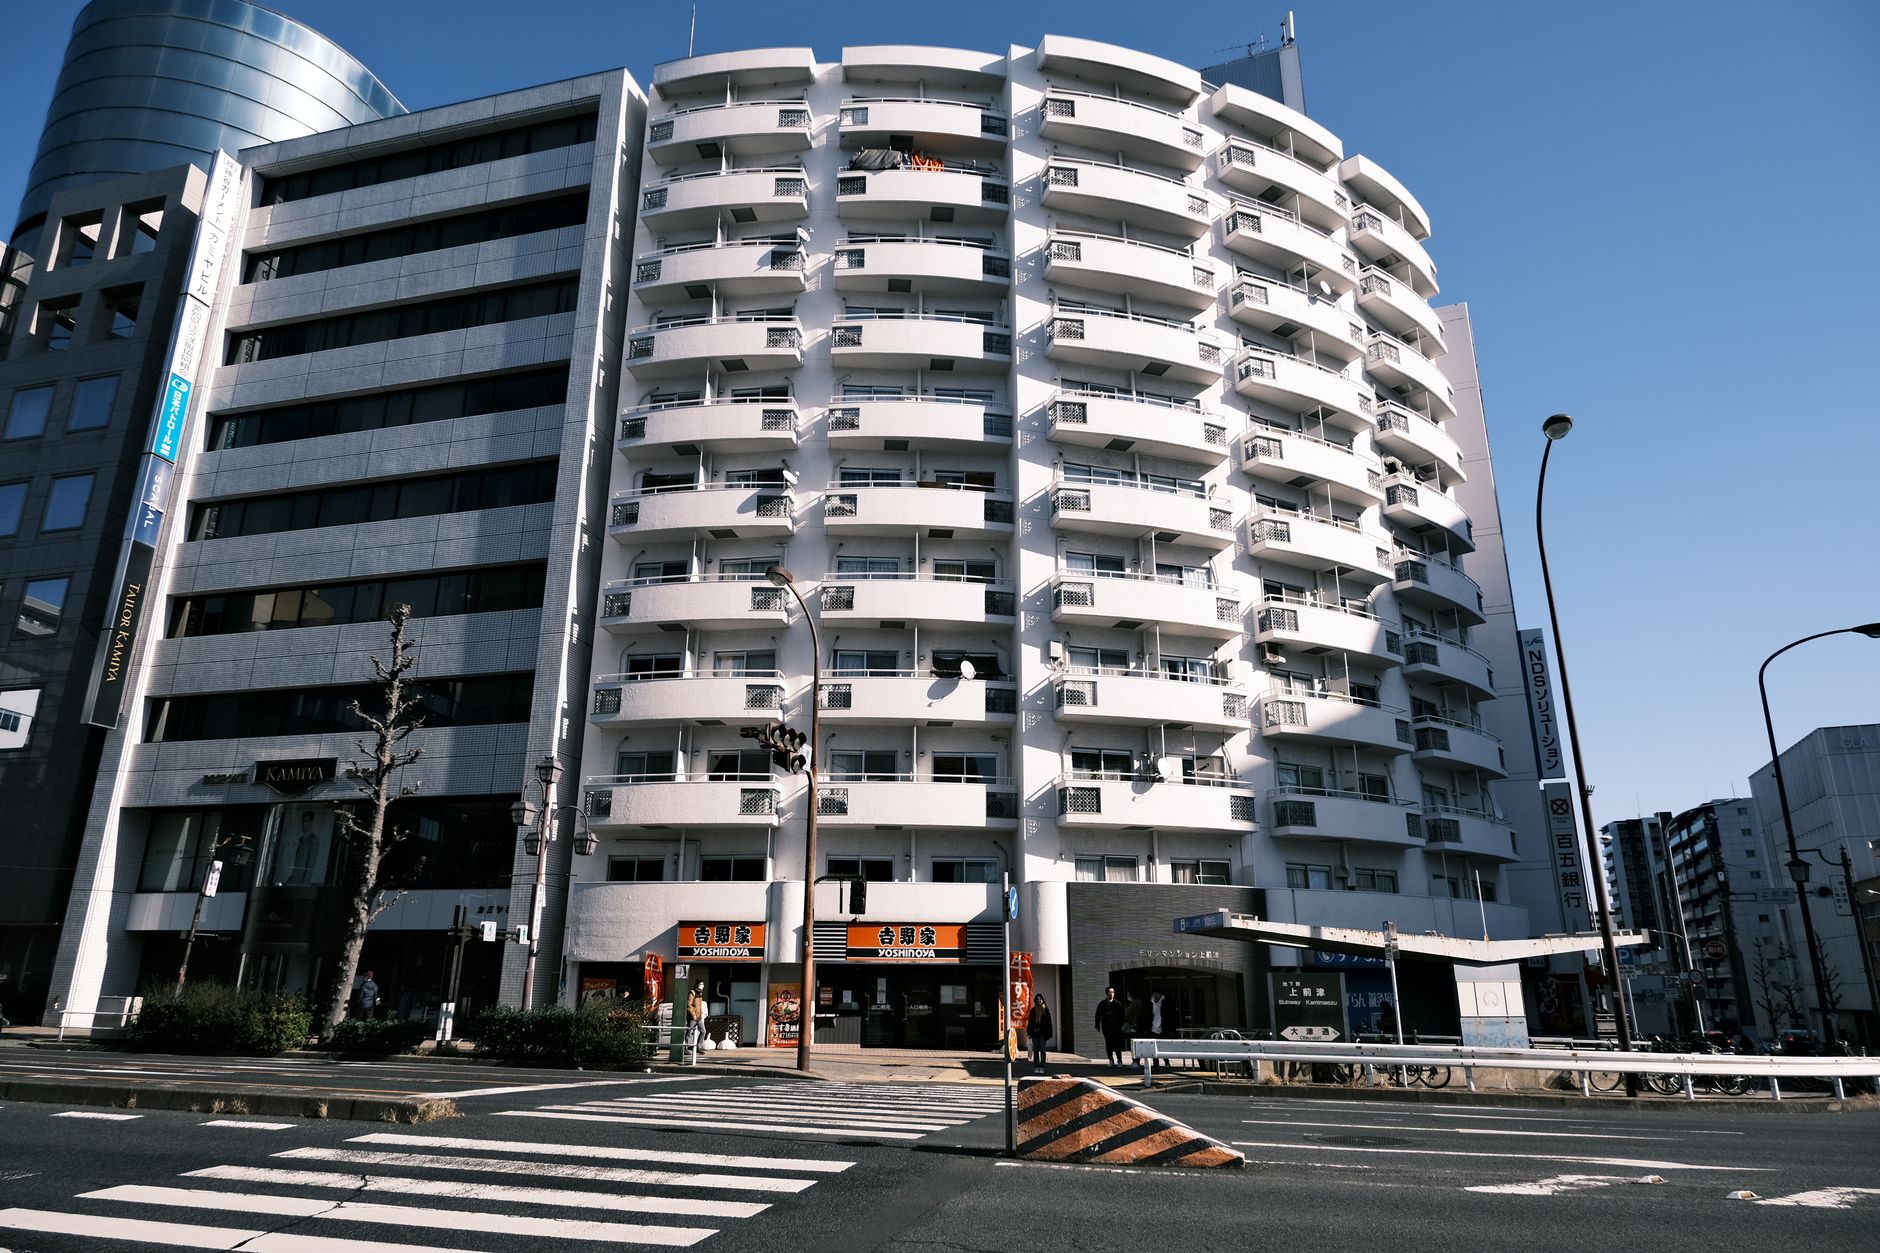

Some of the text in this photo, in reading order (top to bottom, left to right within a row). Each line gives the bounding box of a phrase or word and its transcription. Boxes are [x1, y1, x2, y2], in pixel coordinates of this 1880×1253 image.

[197, 231, 219, 295] カミヤビル
[105, 583, 141, 683] TAILOR KAMIYA
[1528, 649, 1560, 771] NDSソリューション
[265, 766, 325, 782] KAMIYA
[1555, 833, 1583, 909] 百五銀行
[1289, 987, 1326, 997] 上前津
[1290, 1027, 1330, 1036] 大津通
